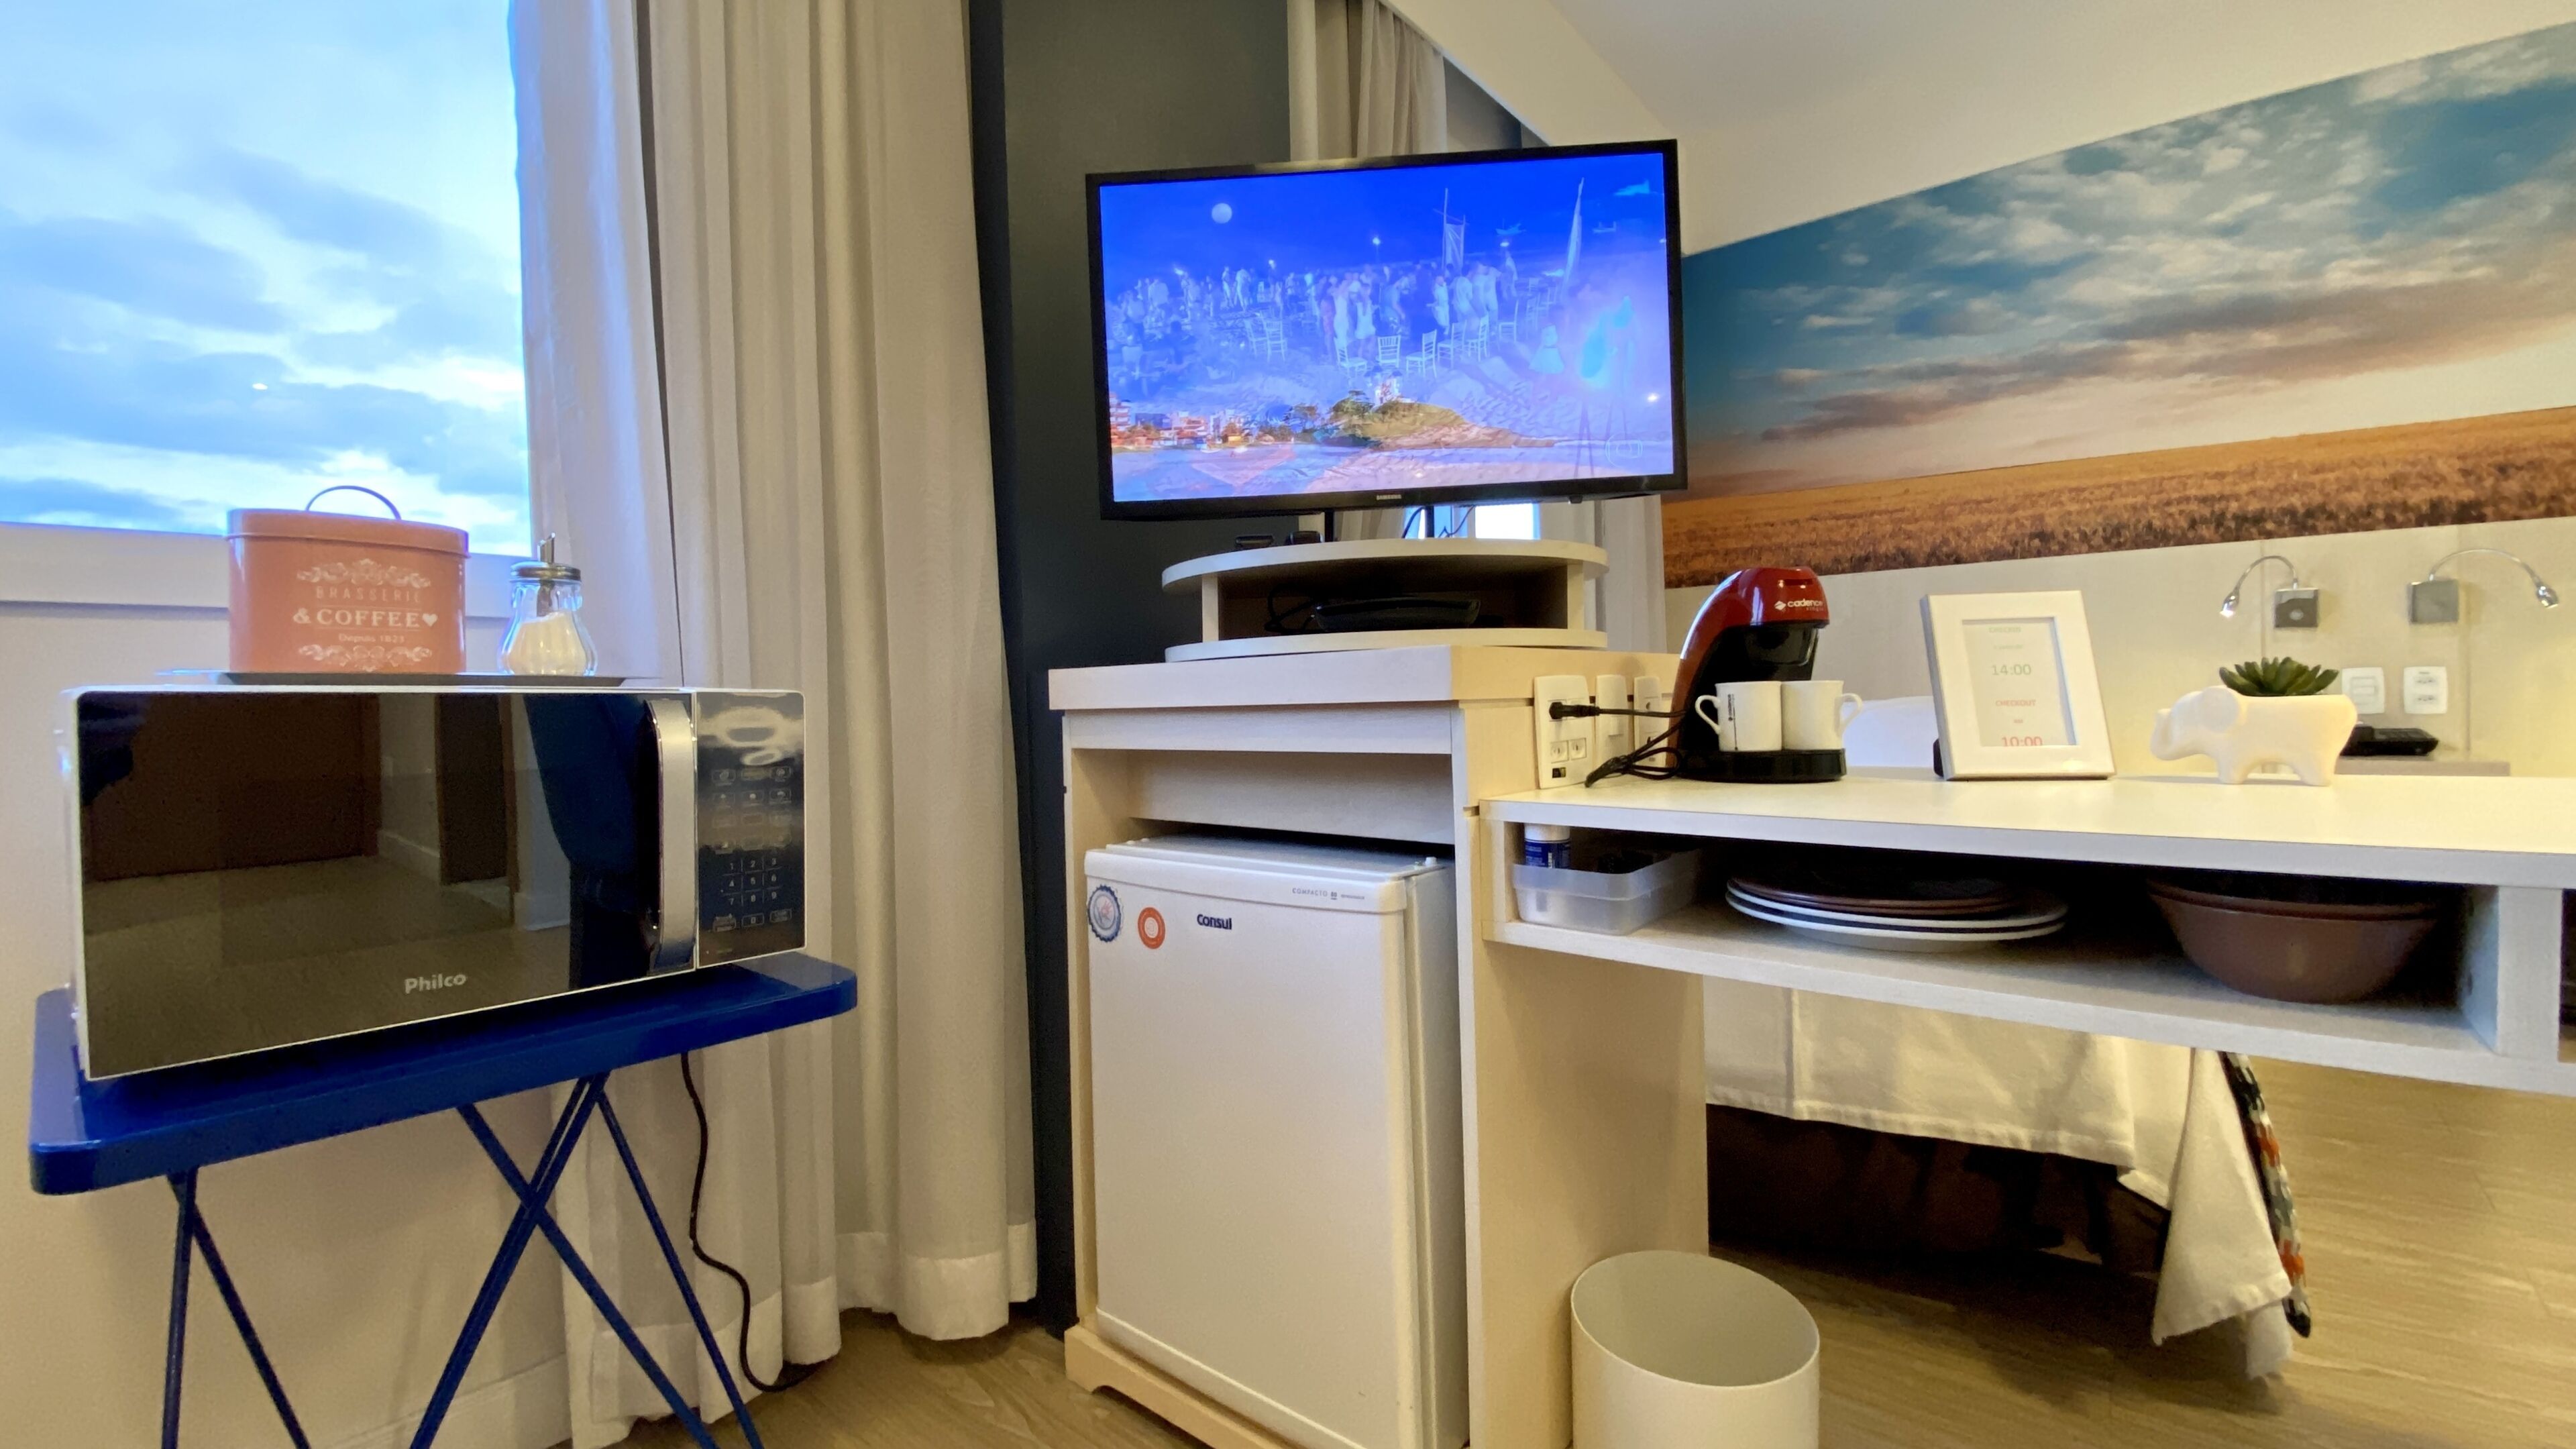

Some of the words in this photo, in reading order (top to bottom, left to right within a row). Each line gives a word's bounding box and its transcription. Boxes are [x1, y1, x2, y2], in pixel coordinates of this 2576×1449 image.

[1787, 598, 1824, 607] cadence
[317, 608, 420, 628] COFFEE
[1992, 664, 2032, 676] 14:00
[1996, 699, 2036, 707] CHECKOUT
[1292, 888, 1328, 897] COMPACTO
[1197, 914, 1232, 930] Consul
[405, 973, 467, 994] Philco
